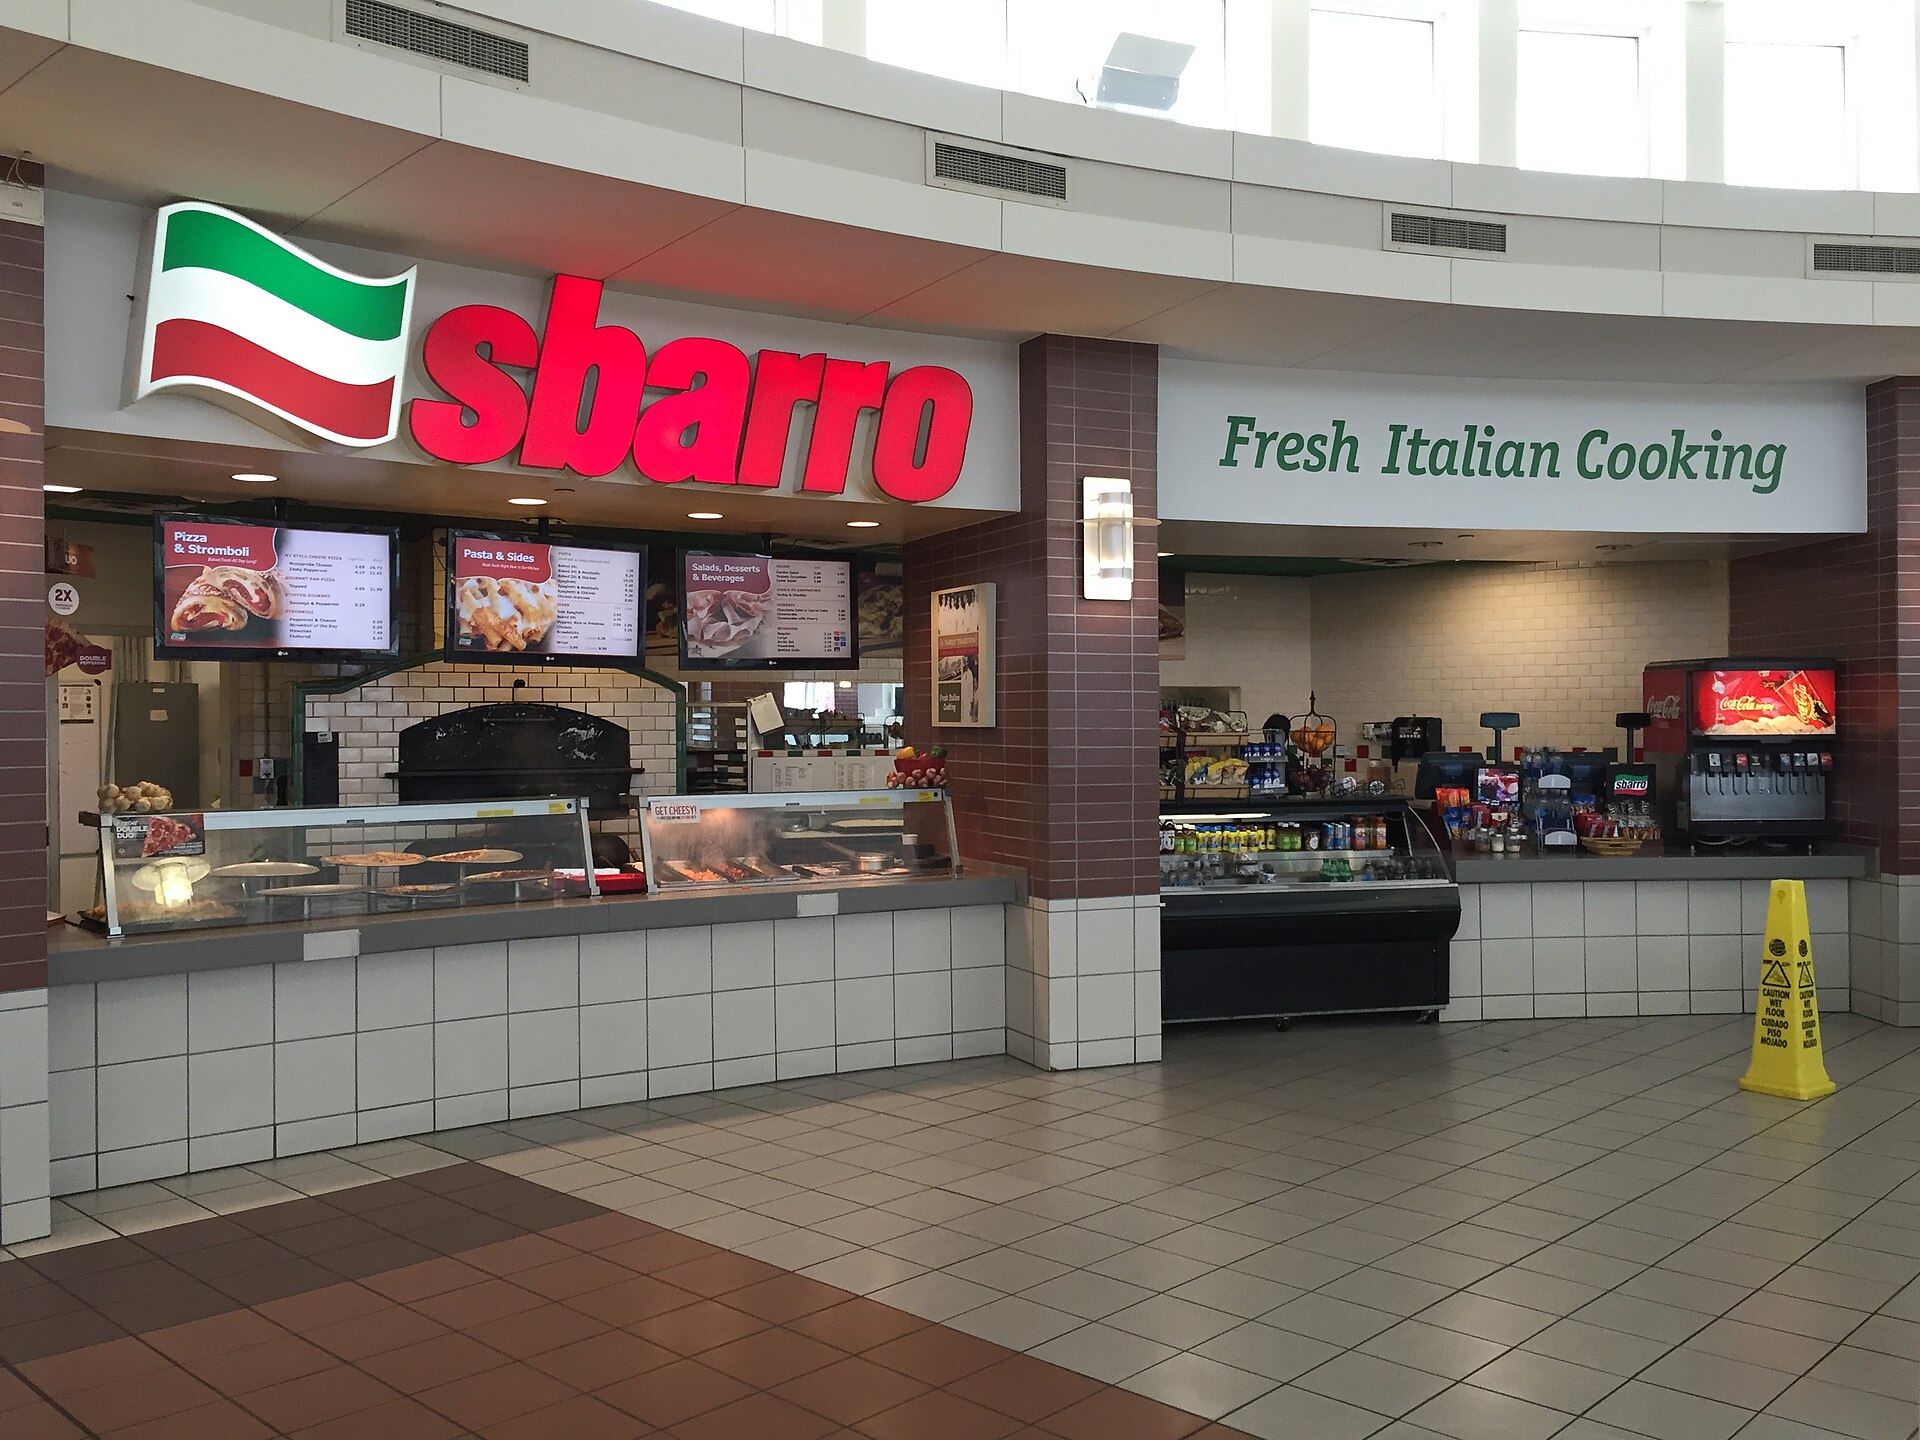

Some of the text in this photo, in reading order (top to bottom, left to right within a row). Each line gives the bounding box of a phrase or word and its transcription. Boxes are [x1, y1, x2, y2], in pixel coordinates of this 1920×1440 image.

[409, 272, 973, 503] sbarro
[1219, 415, 1787, 494] Fresh Italian Cooking
[174, 532, 207, 542] Pizza
[174, 544, 249, 556] & Stromboli
[464, 549, 534, 562] Pasta & Sides
[692, 564, 722, 572] Salads,
[702, 573, 744, 583] Beverages
[55, 589, 72, 602] 2X
[1616, 779, 1647, 789] sbarro
[655, 806, 697, 815] GET CHEESY!
[1762, 988, 1790, 1000] CAUTION
[1769, 998, 1782, 1008] WET
[1765, 1007, 1785, 1018] FLOOR
[1761, 1018, 1789, 1030] CUIDADO
[1767, 1028, 1782, 1038] PISO
[1760, 1036, 1788, 1049] MOJADO
